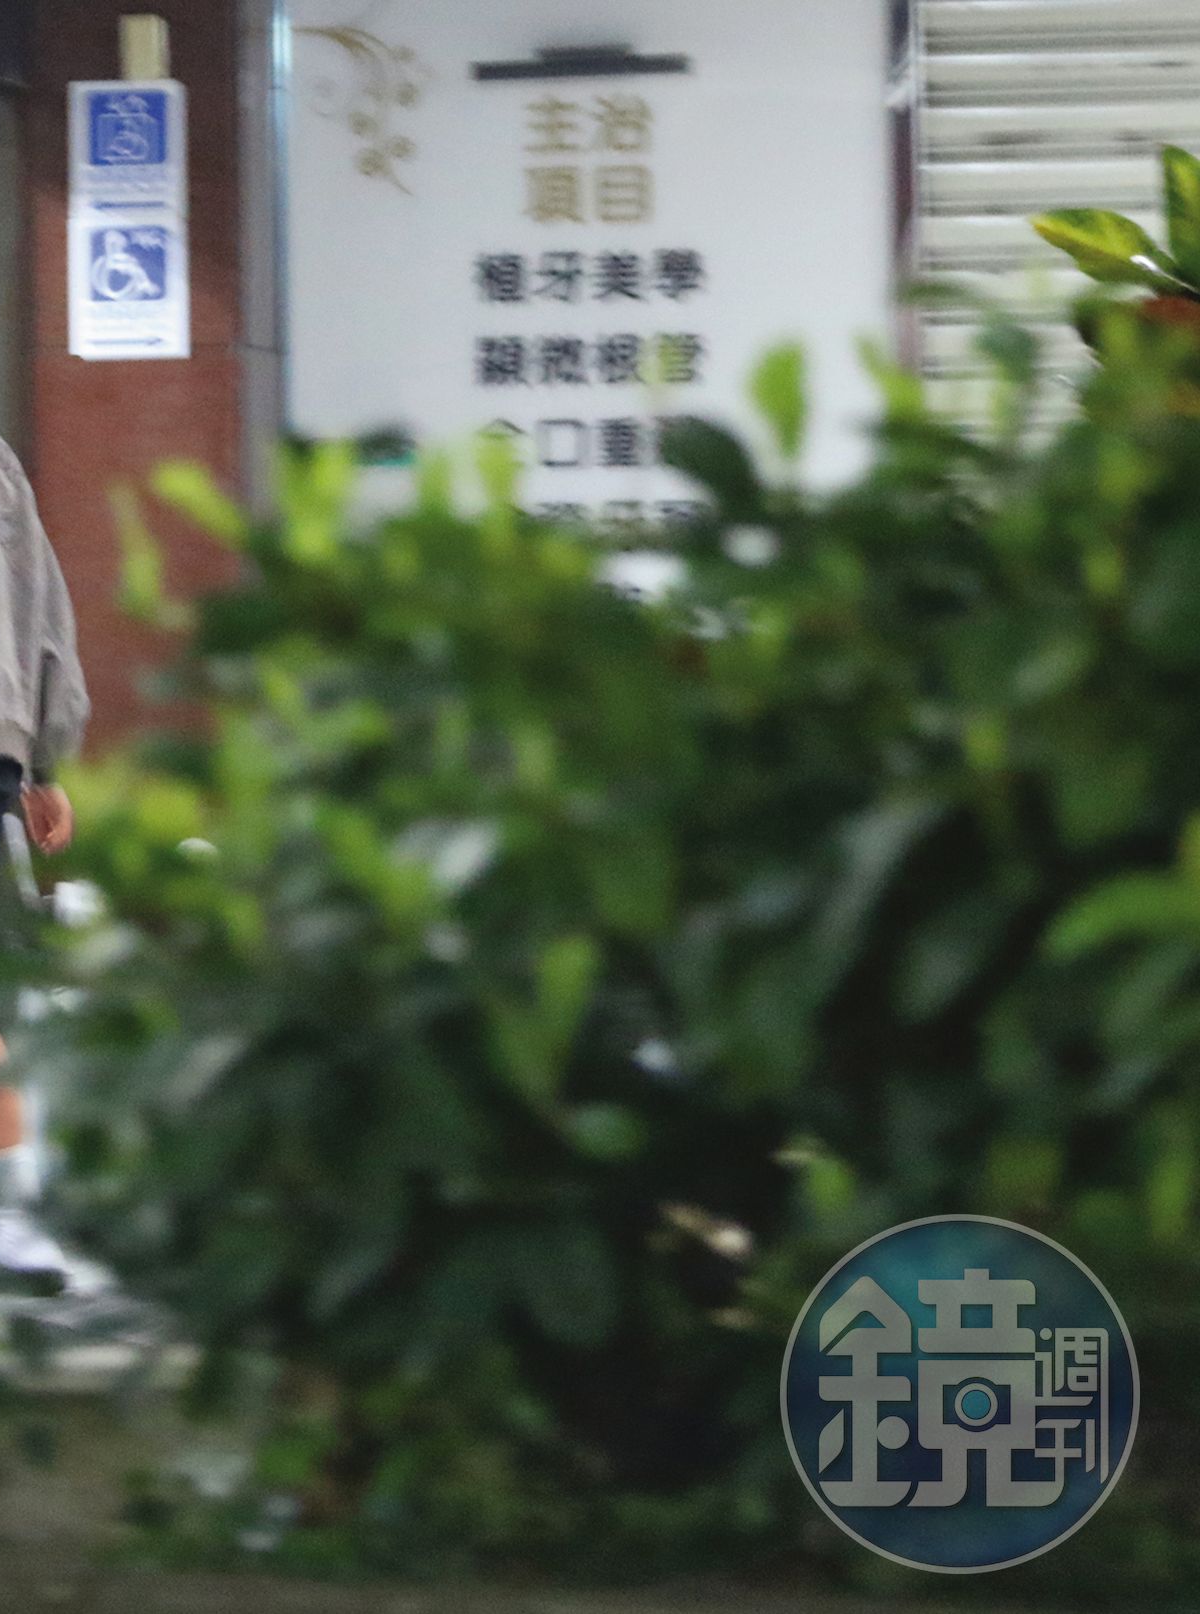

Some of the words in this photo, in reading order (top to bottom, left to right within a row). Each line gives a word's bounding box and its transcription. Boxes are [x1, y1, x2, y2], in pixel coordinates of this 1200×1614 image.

[522, 96, 653, 152] 主治
[522, 165, 654, 223] 項目
[475, 249, 704, 302] 植牙美學
